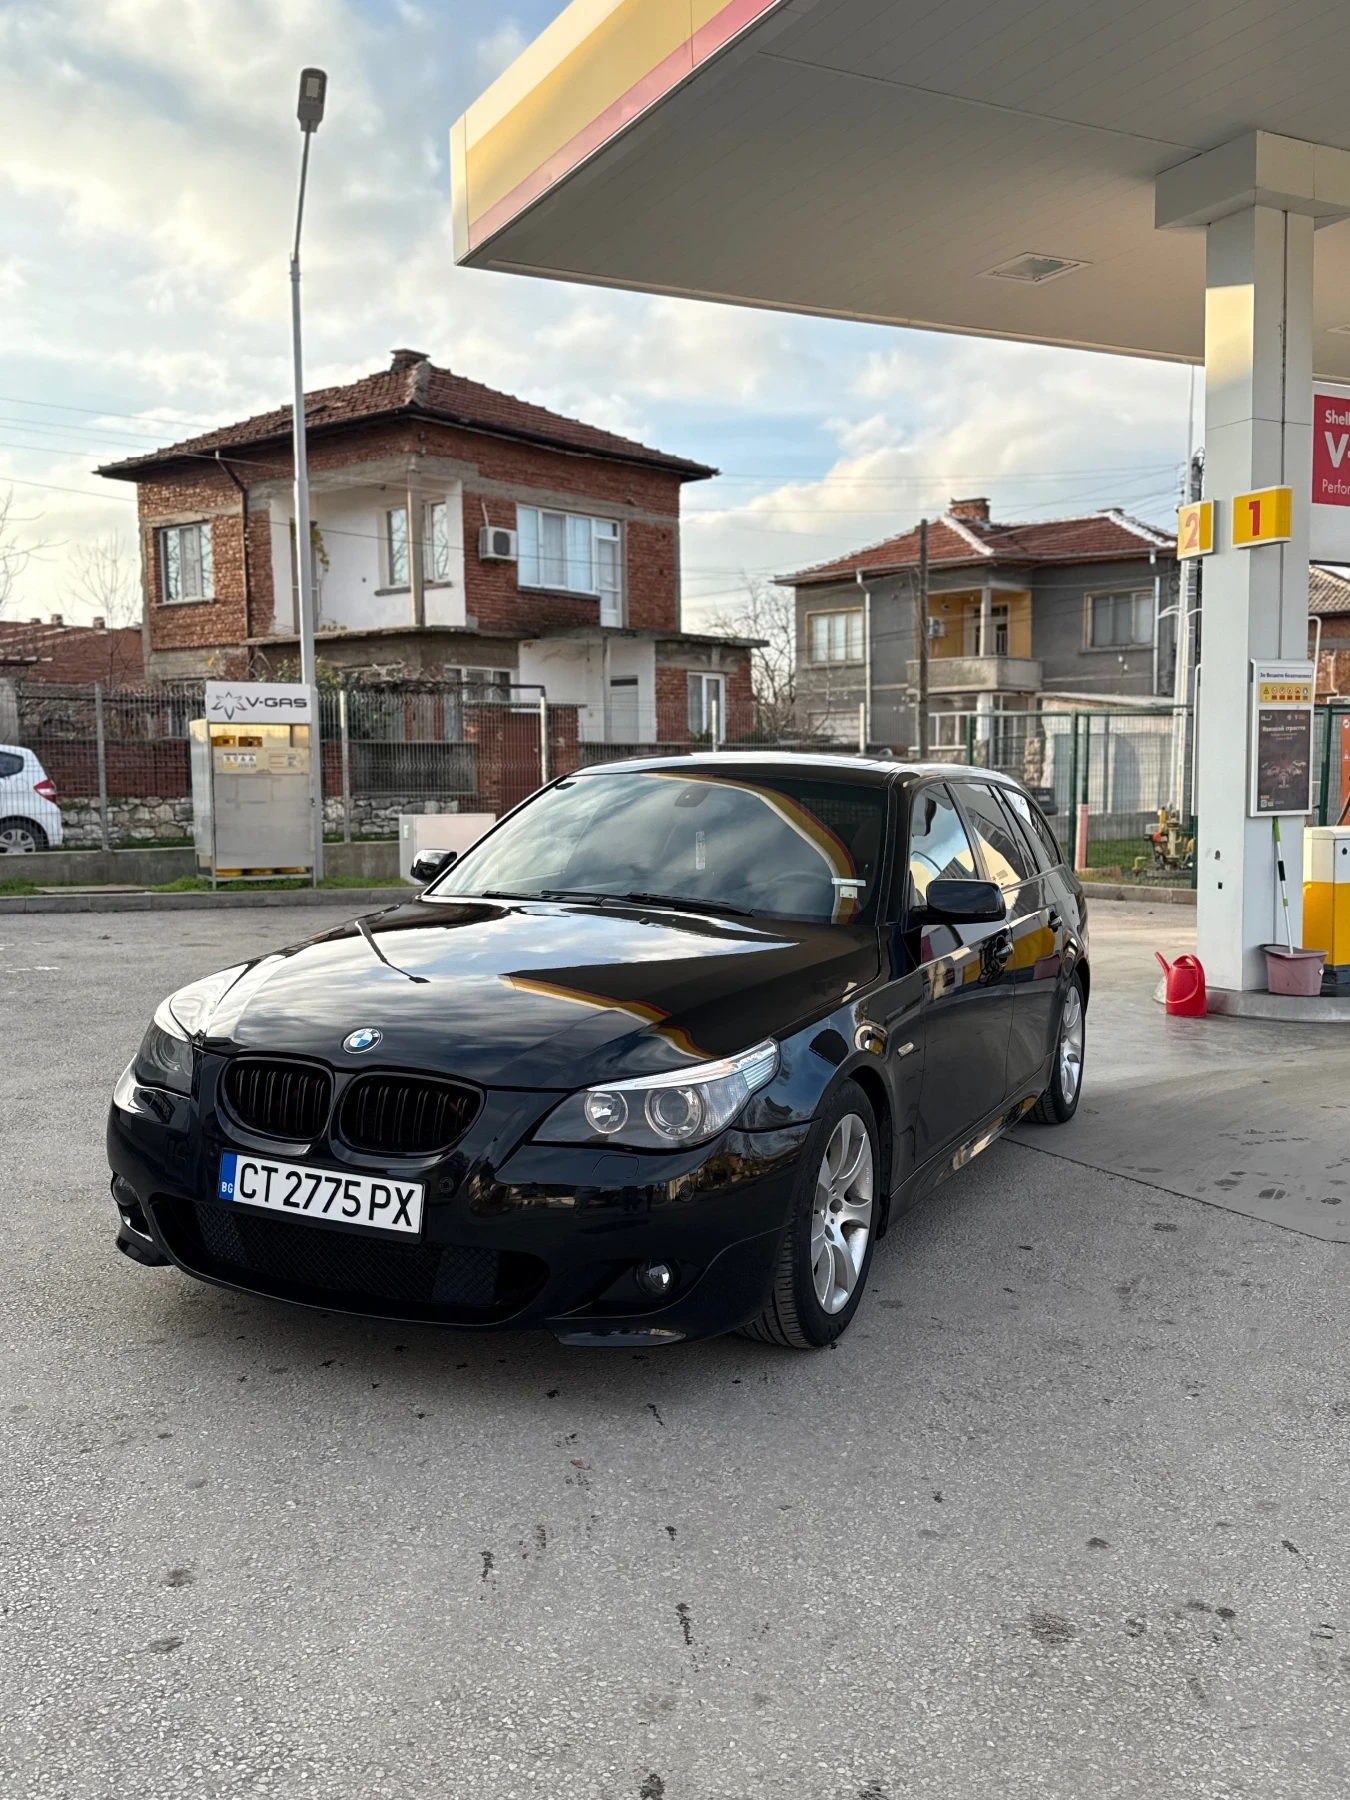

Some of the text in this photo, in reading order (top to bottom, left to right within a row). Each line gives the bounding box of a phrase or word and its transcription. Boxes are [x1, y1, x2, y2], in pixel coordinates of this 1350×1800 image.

[1324, 409, 1350, 426] Shell
[1185, 512, 1200, 549] 2
[1248, 500, 1261, 537] 1
[245, 696, 308, 708] V-GAS
[221, 1181, 234, 1194] BG
[239, 1162, 416, 1227] CT 2775 PX
